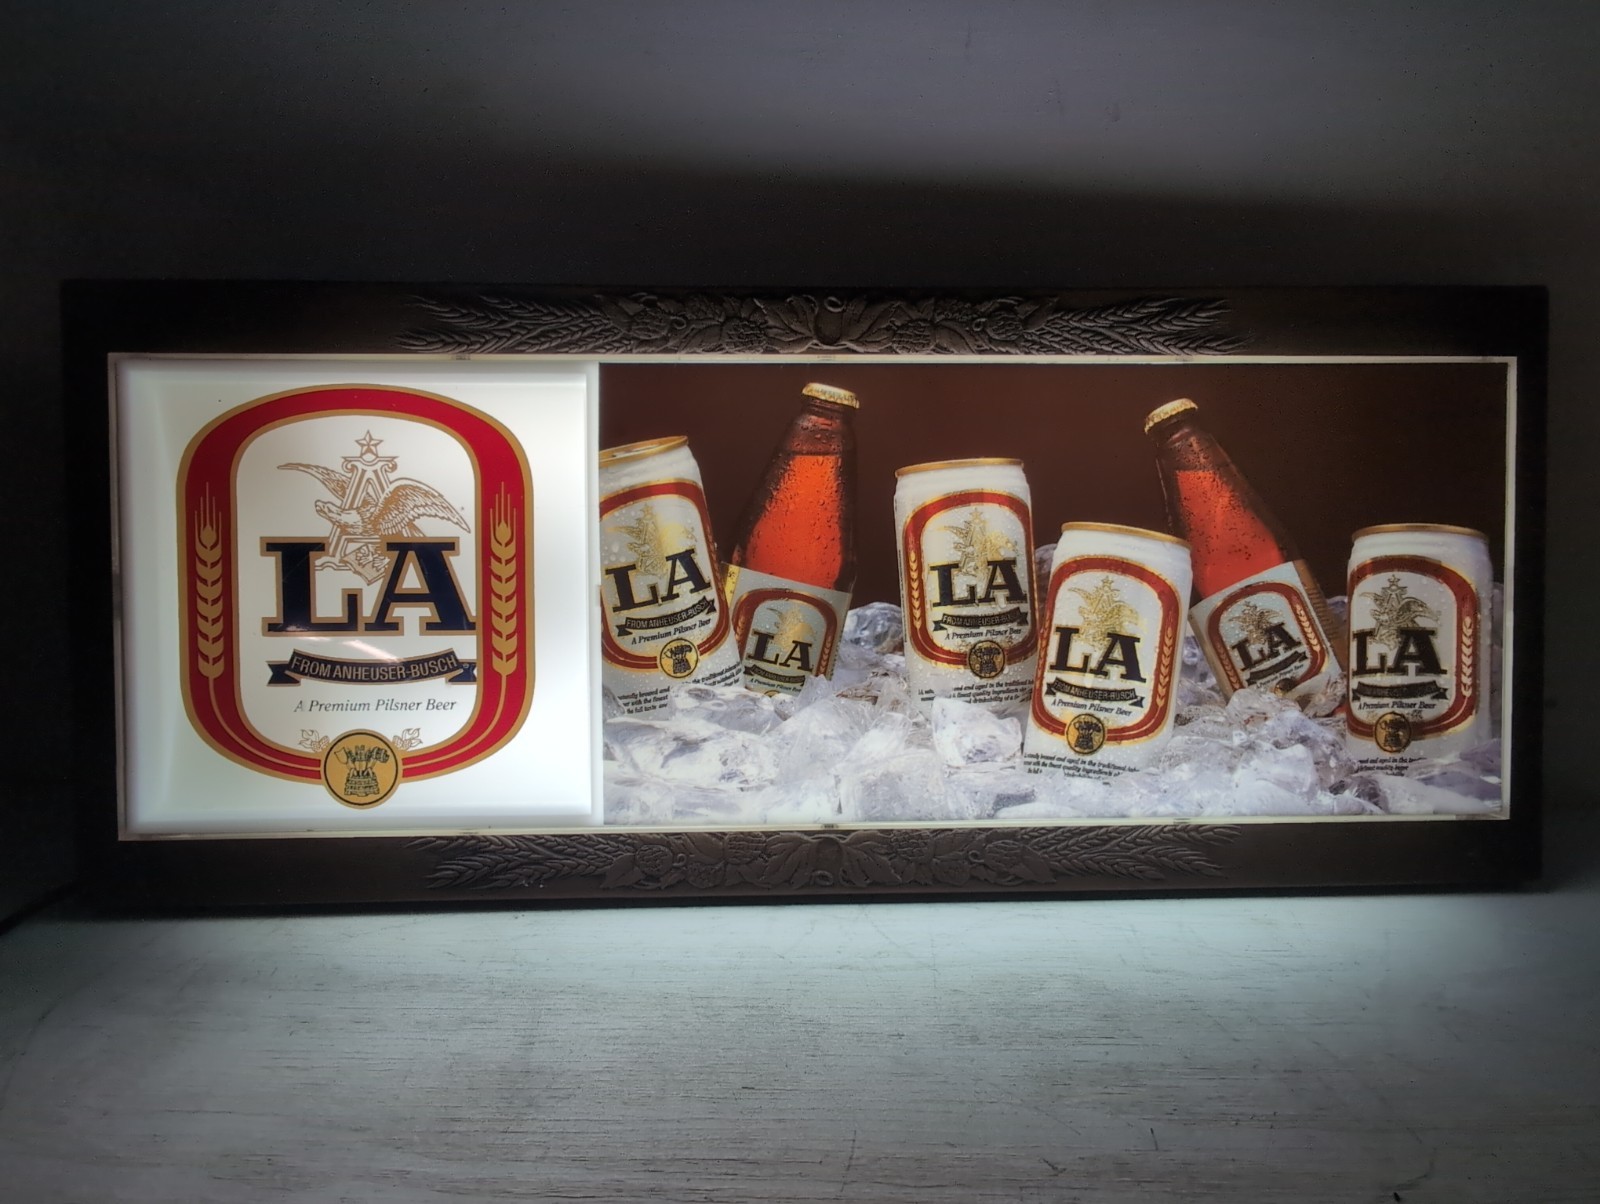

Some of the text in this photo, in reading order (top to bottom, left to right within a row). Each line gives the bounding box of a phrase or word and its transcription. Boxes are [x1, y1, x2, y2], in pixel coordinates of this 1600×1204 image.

[259, 536, 477, 637] LA
[605, 548, 711, 613] LA
[930, 559, 1028, 608] LA
[626, 618, 648, 629] FROM
[638, 631, 671, 643] Premium
[951, 631, 983, 639] Premium
[291, 654, 458, 681] FROM ANHEUSER-BUSCH
[746, 630, 813, 673] LA
[1049, 626, 1147, 683] LA
[1232, 622, 1302, 672] LA
[1353, 627, 1447, 676] LA
[294, 698, 457, 713] A Premium Pilsner Beer
[1056, 699, 1087, 710] Premium
[1089, 702, 1115, 714] Pilsner
[1116, 707, 1133, 716] Beer
